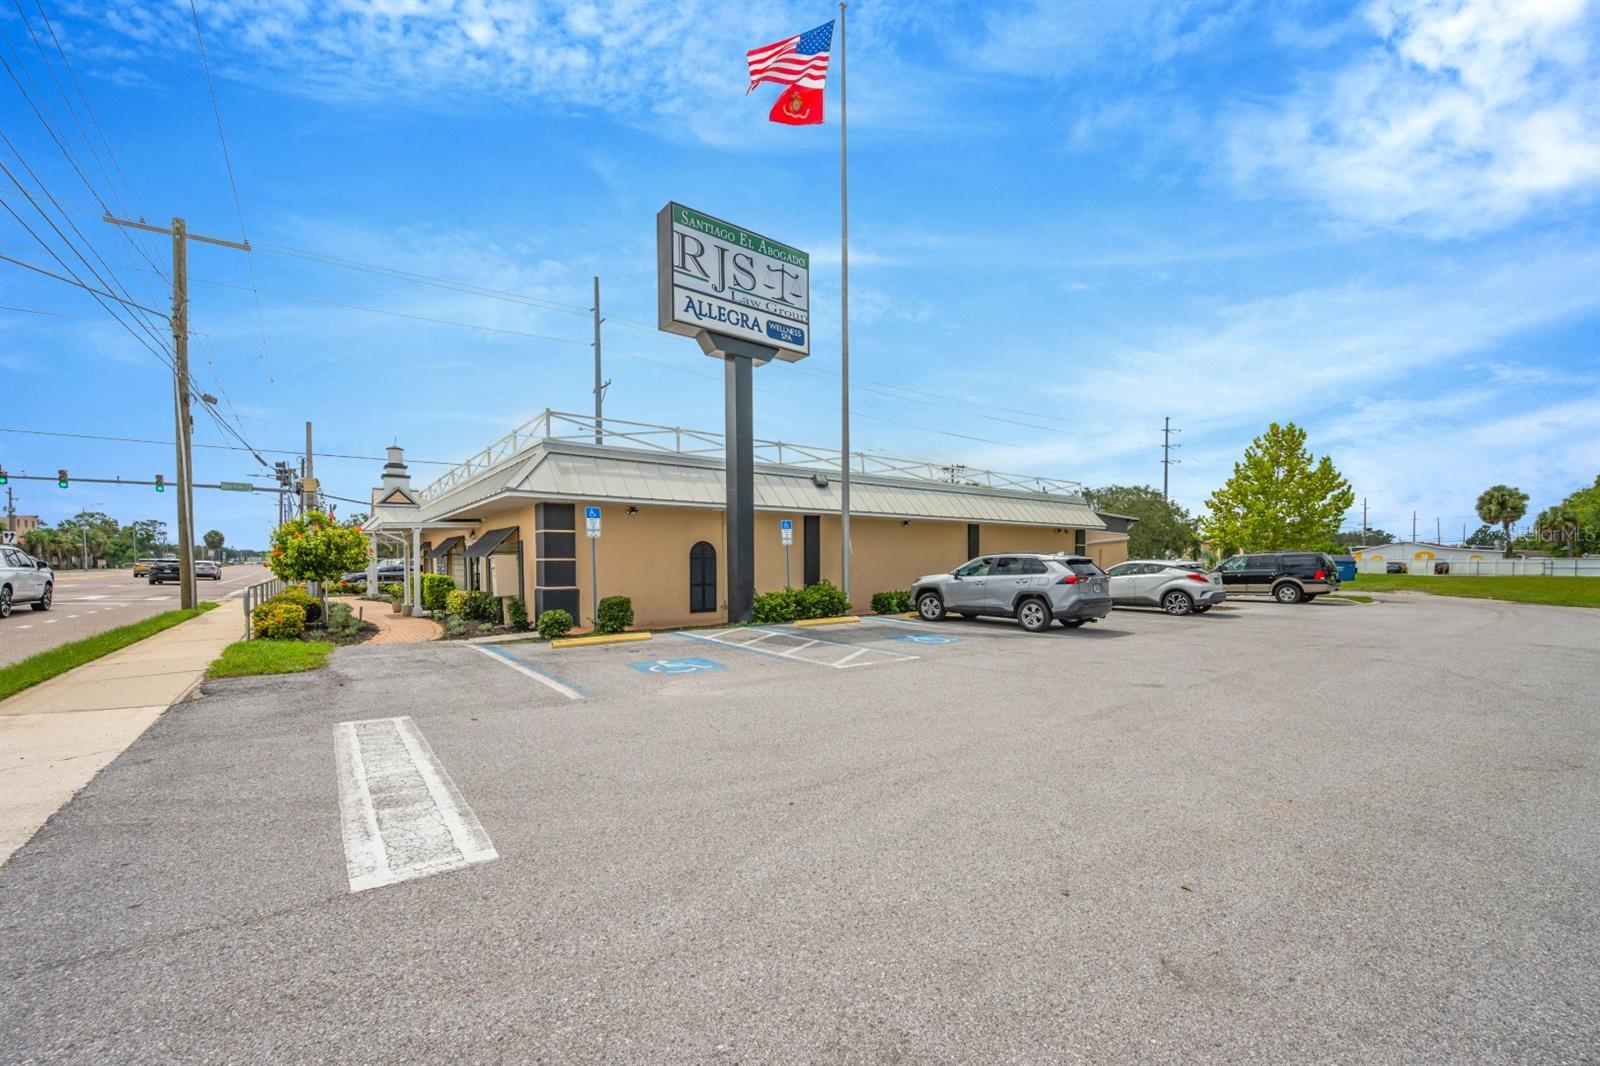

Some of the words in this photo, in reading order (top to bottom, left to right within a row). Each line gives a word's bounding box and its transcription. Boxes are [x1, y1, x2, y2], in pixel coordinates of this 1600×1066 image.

[681, 210, 735, 242] SANTIAGO
[740, 232, 754, 249] EL
[758, 240, 805, 267] ABOGADO
[673, 231, 757, 293] RJS
[731, 291, 761, 308] Law
[683, 295, 763, 333] ALLEGRA
[768, 322, 802, 337] WELLNESS
[781, 333, 793, 342] SPA
